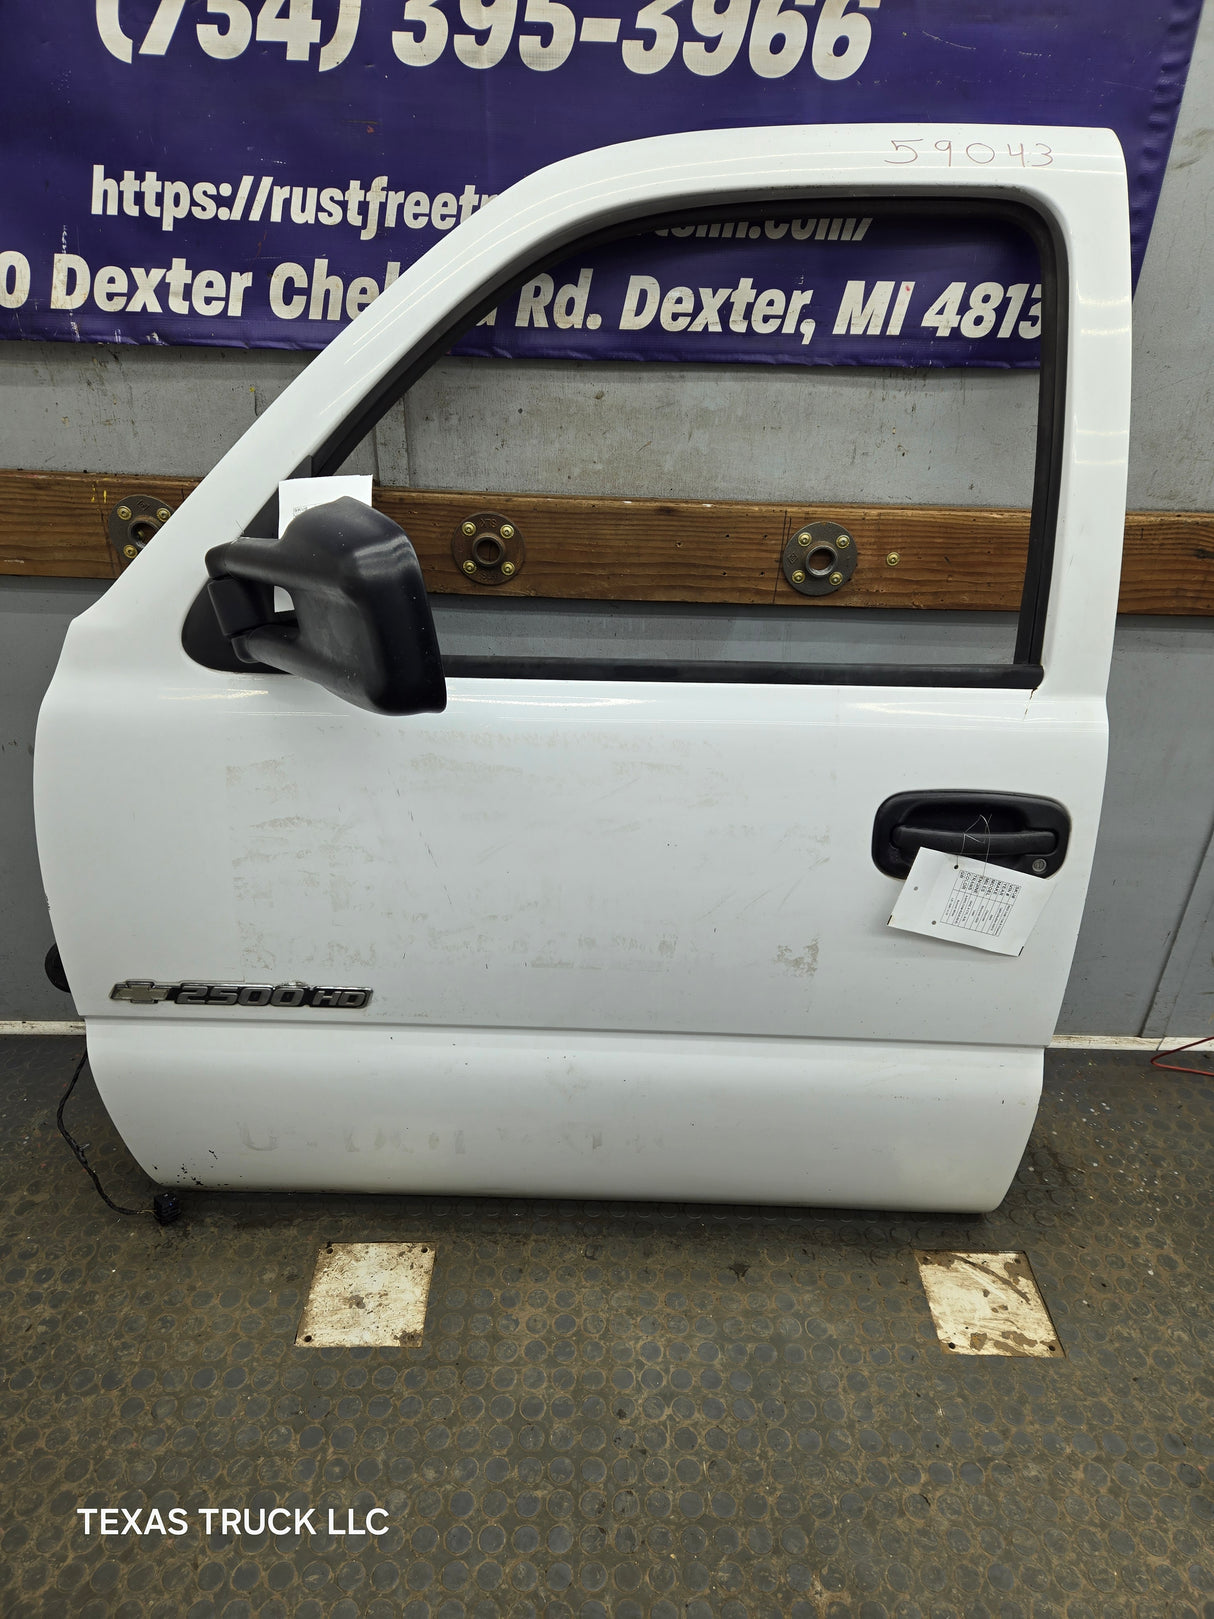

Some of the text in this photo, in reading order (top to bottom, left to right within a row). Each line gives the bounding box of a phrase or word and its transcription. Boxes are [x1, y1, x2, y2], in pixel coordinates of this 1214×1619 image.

[884, 138, 1053, 167] 59043
[50, 257, 253, 317] Dexter
[515, 268, 602, 330] Rd.
[619, 275, 814, 345] Dexter,
[832, 280, 916, 336] MI
[176, 986, 367, 1006] 2500 HD
